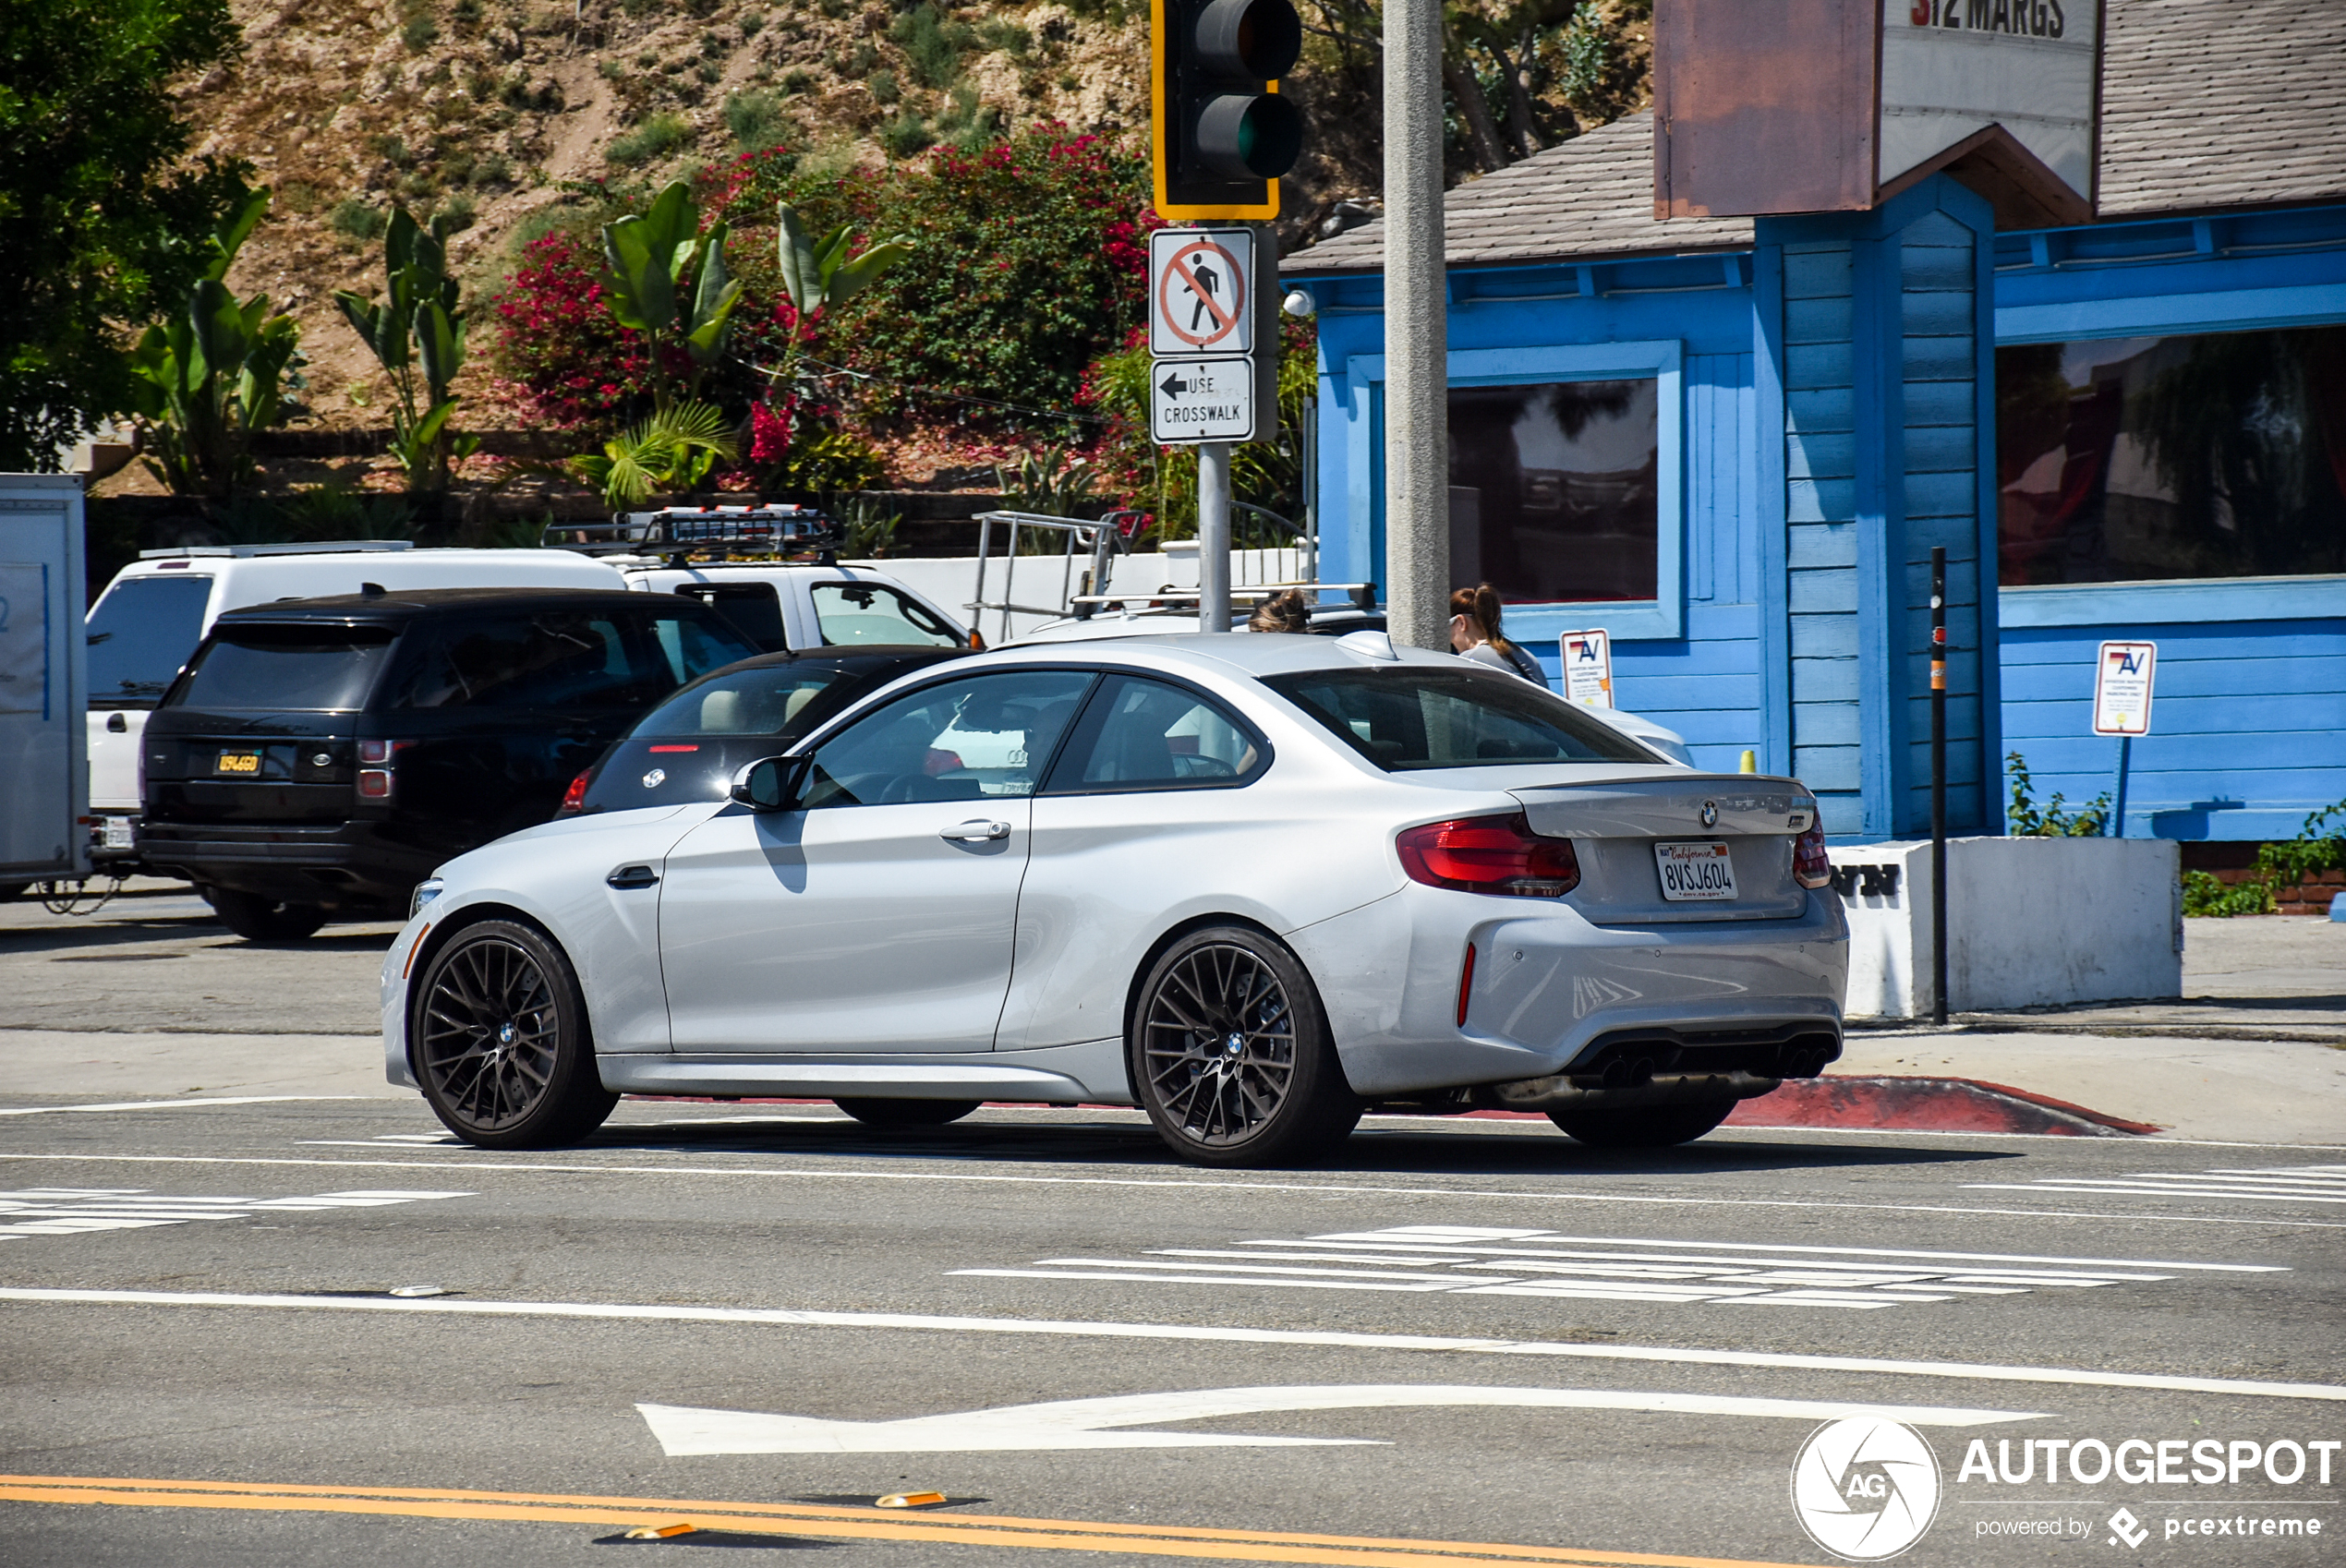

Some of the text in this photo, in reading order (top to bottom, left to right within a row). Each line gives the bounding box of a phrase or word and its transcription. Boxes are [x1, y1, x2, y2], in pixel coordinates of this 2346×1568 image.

[1967, 0, 2064, 38] MARGS
[1189, 377, 1215, 393] USE
[1164, 404, 1240, 424] CROSSWALK
[1671, 846, 1717, 863] California
[1665, 862, 1732, 891] 8VSJ604
